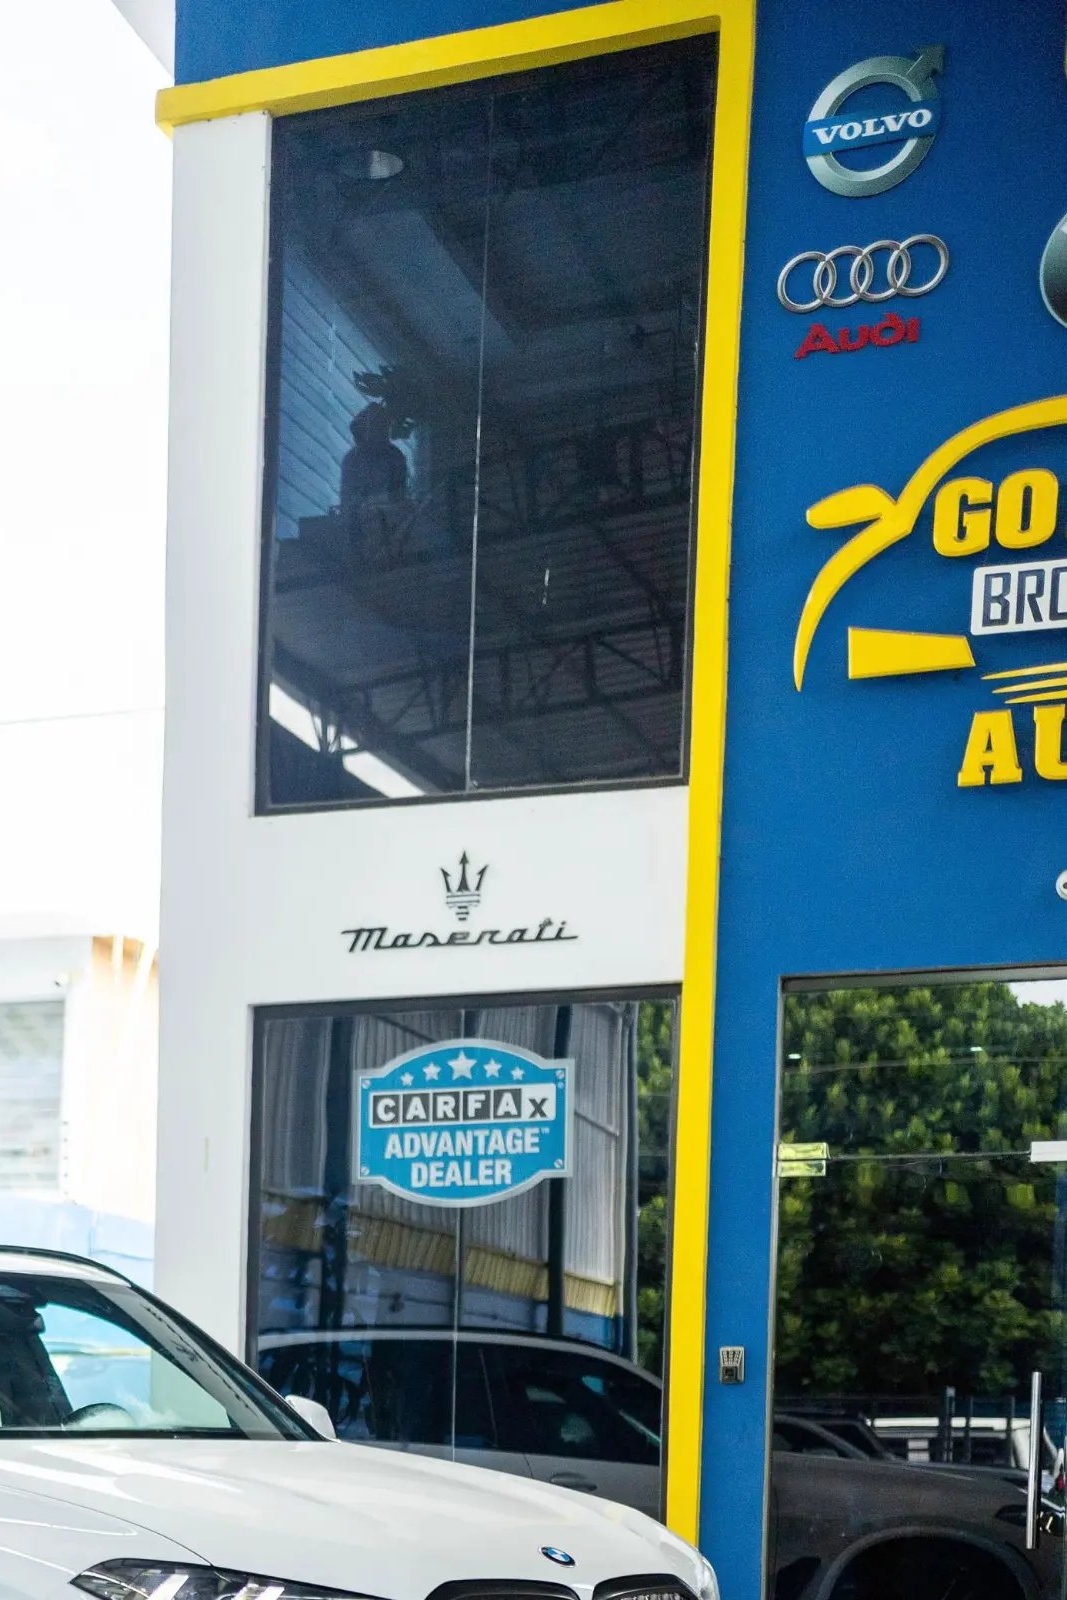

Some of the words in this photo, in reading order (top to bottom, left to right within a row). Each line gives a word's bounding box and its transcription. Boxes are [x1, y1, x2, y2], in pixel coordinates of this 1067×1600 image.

[812, 108, 933, 145] VOLVO
[794, 312, 921, 360] Audi
[341, 918, 579, 953] Maserati
[374, 1090, 550, 1123] CARFAX
[410, 1159, 512, 1188] DEALER
